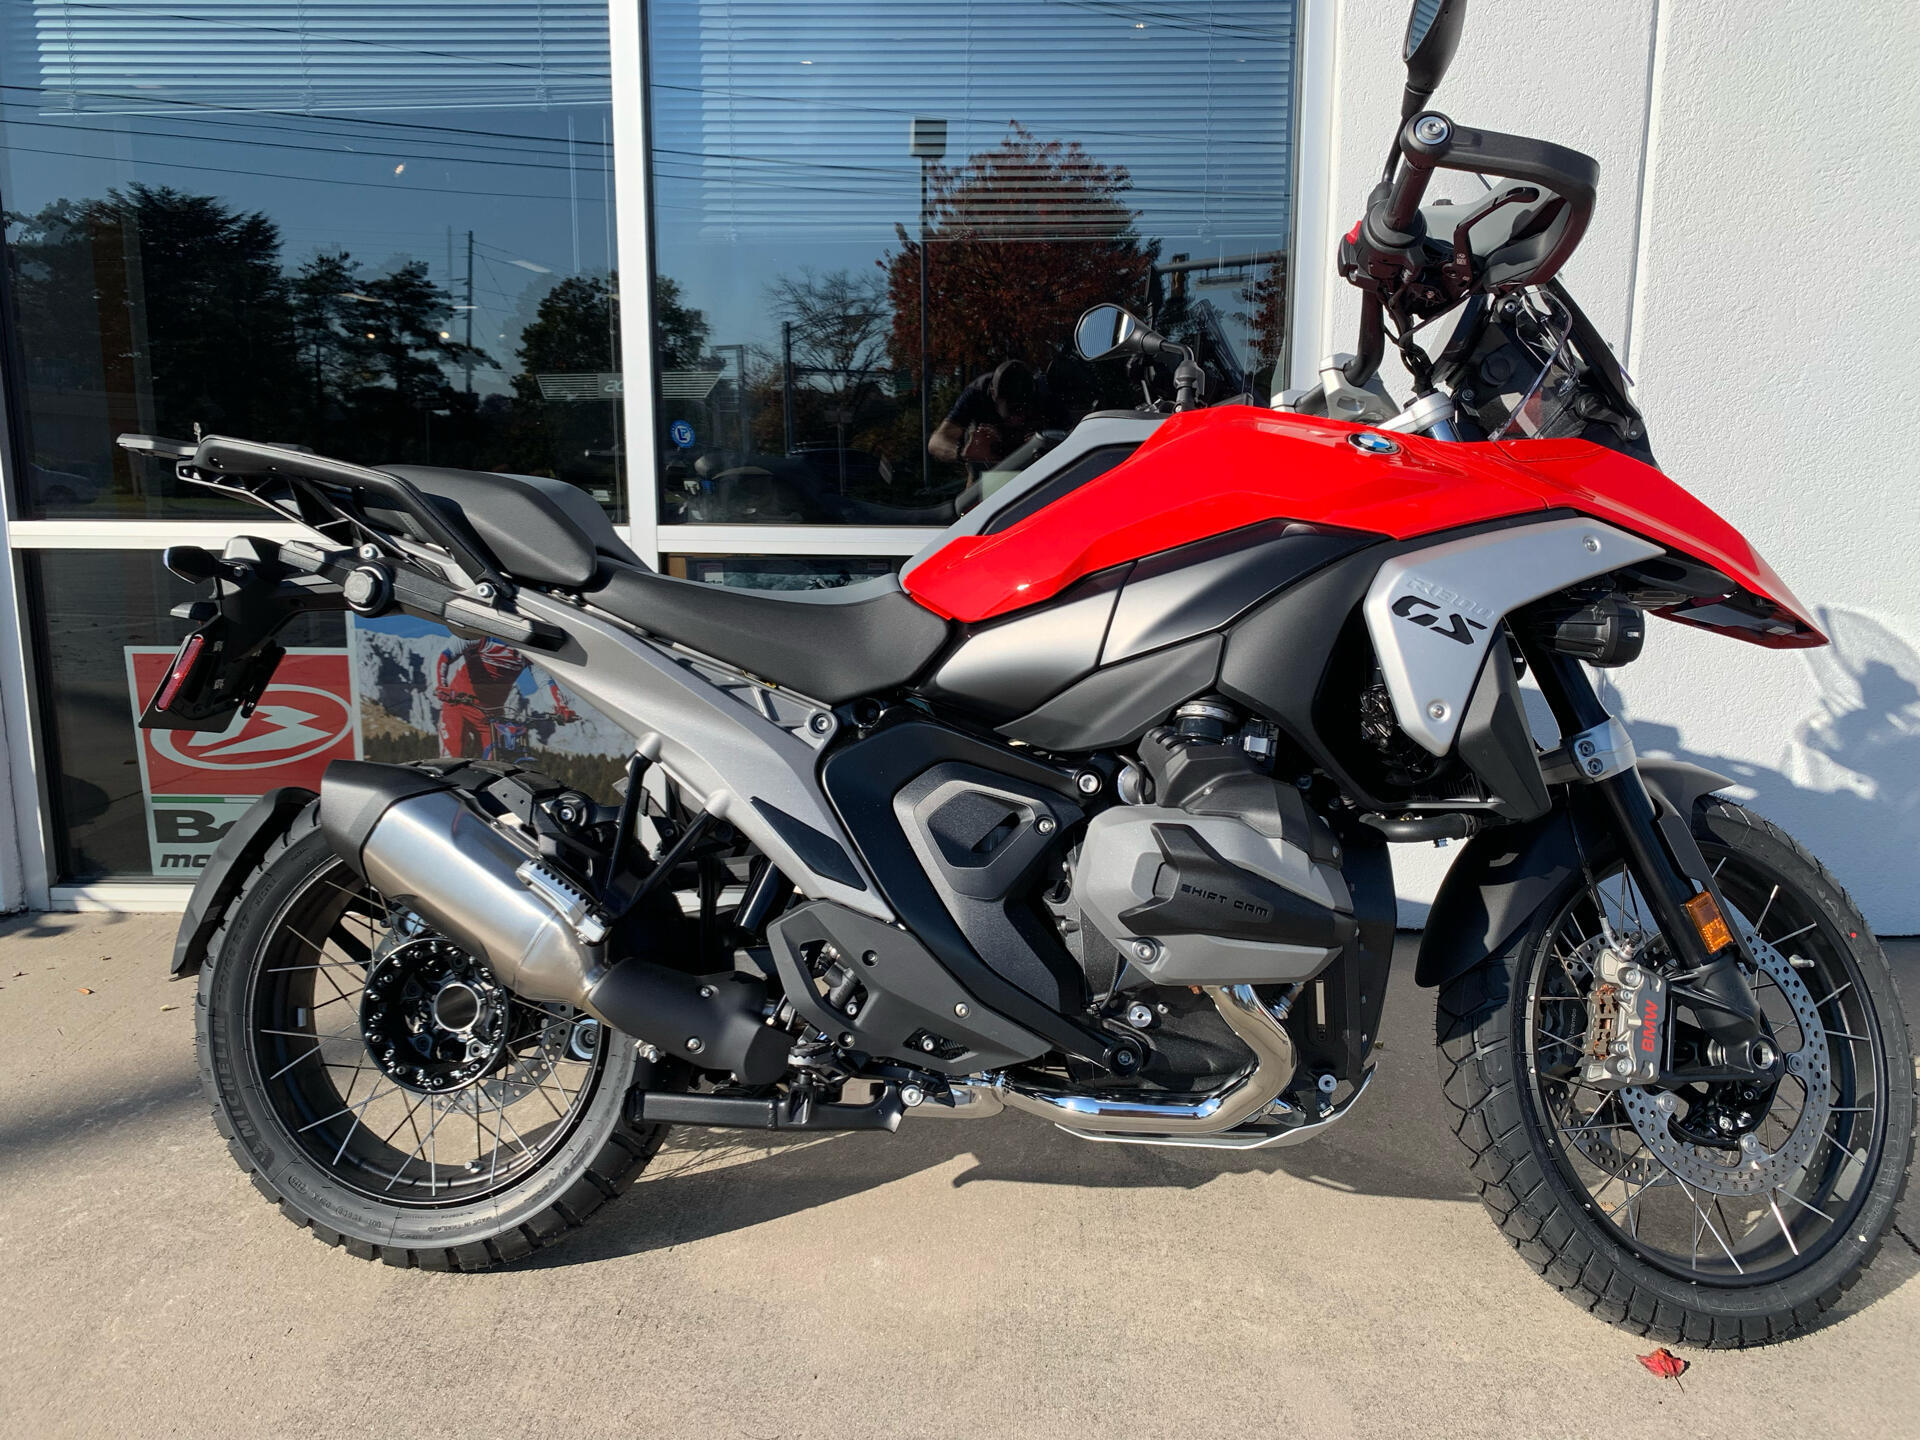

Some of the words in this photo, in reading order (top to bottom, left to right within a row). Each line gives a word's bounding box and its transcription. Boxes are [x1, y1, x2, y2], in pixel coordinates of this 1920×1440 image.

[1391, 595, 1488, 645] GS
[1181, 883, 1228, 904] SHIFT
[1233, 900, 1270, 917] CAM
[1641, 999, 1659, 1053] BMW
[213, 1015, 257, 1144] MICHELIN
